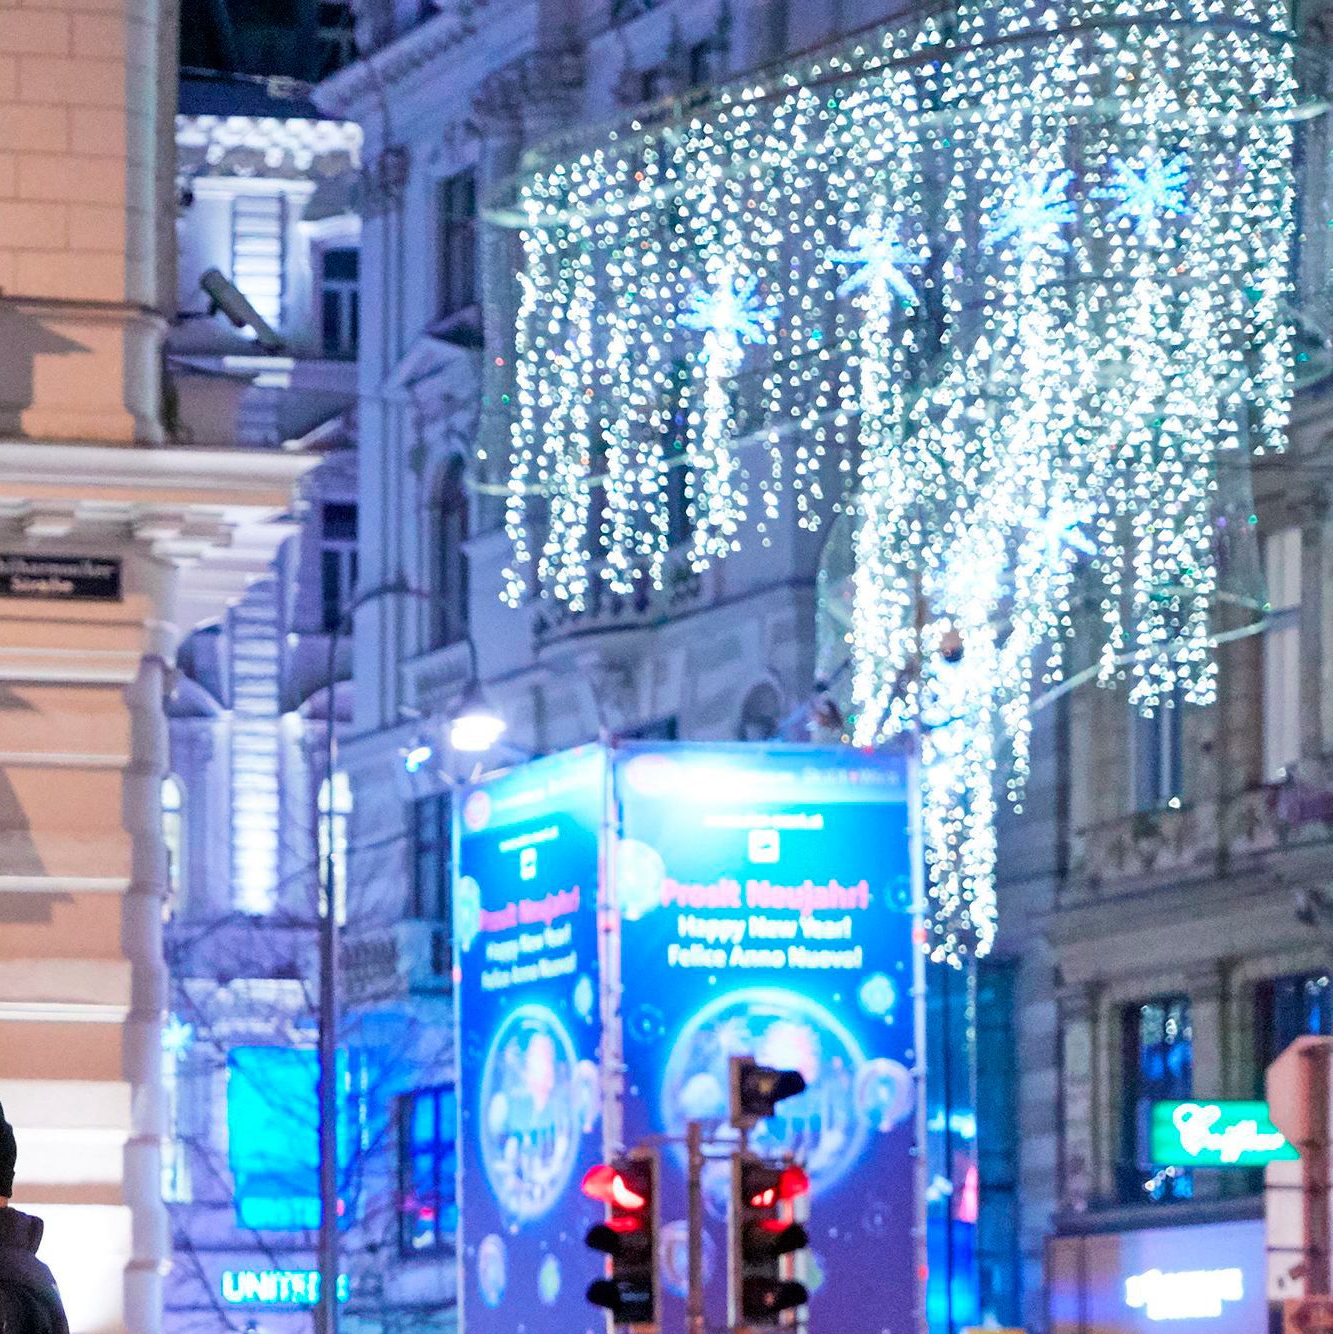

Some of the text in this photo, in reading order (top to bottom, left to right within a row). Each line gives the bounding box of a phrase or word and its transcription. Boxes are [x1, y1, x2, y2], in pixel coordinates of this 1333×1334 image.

[661, 878, 870, 917] Prosit Neujahr!
[677, 913, 852, 944] Happy New Year!
[667, 943, 863, 969] Felice Anno Nuovo!
